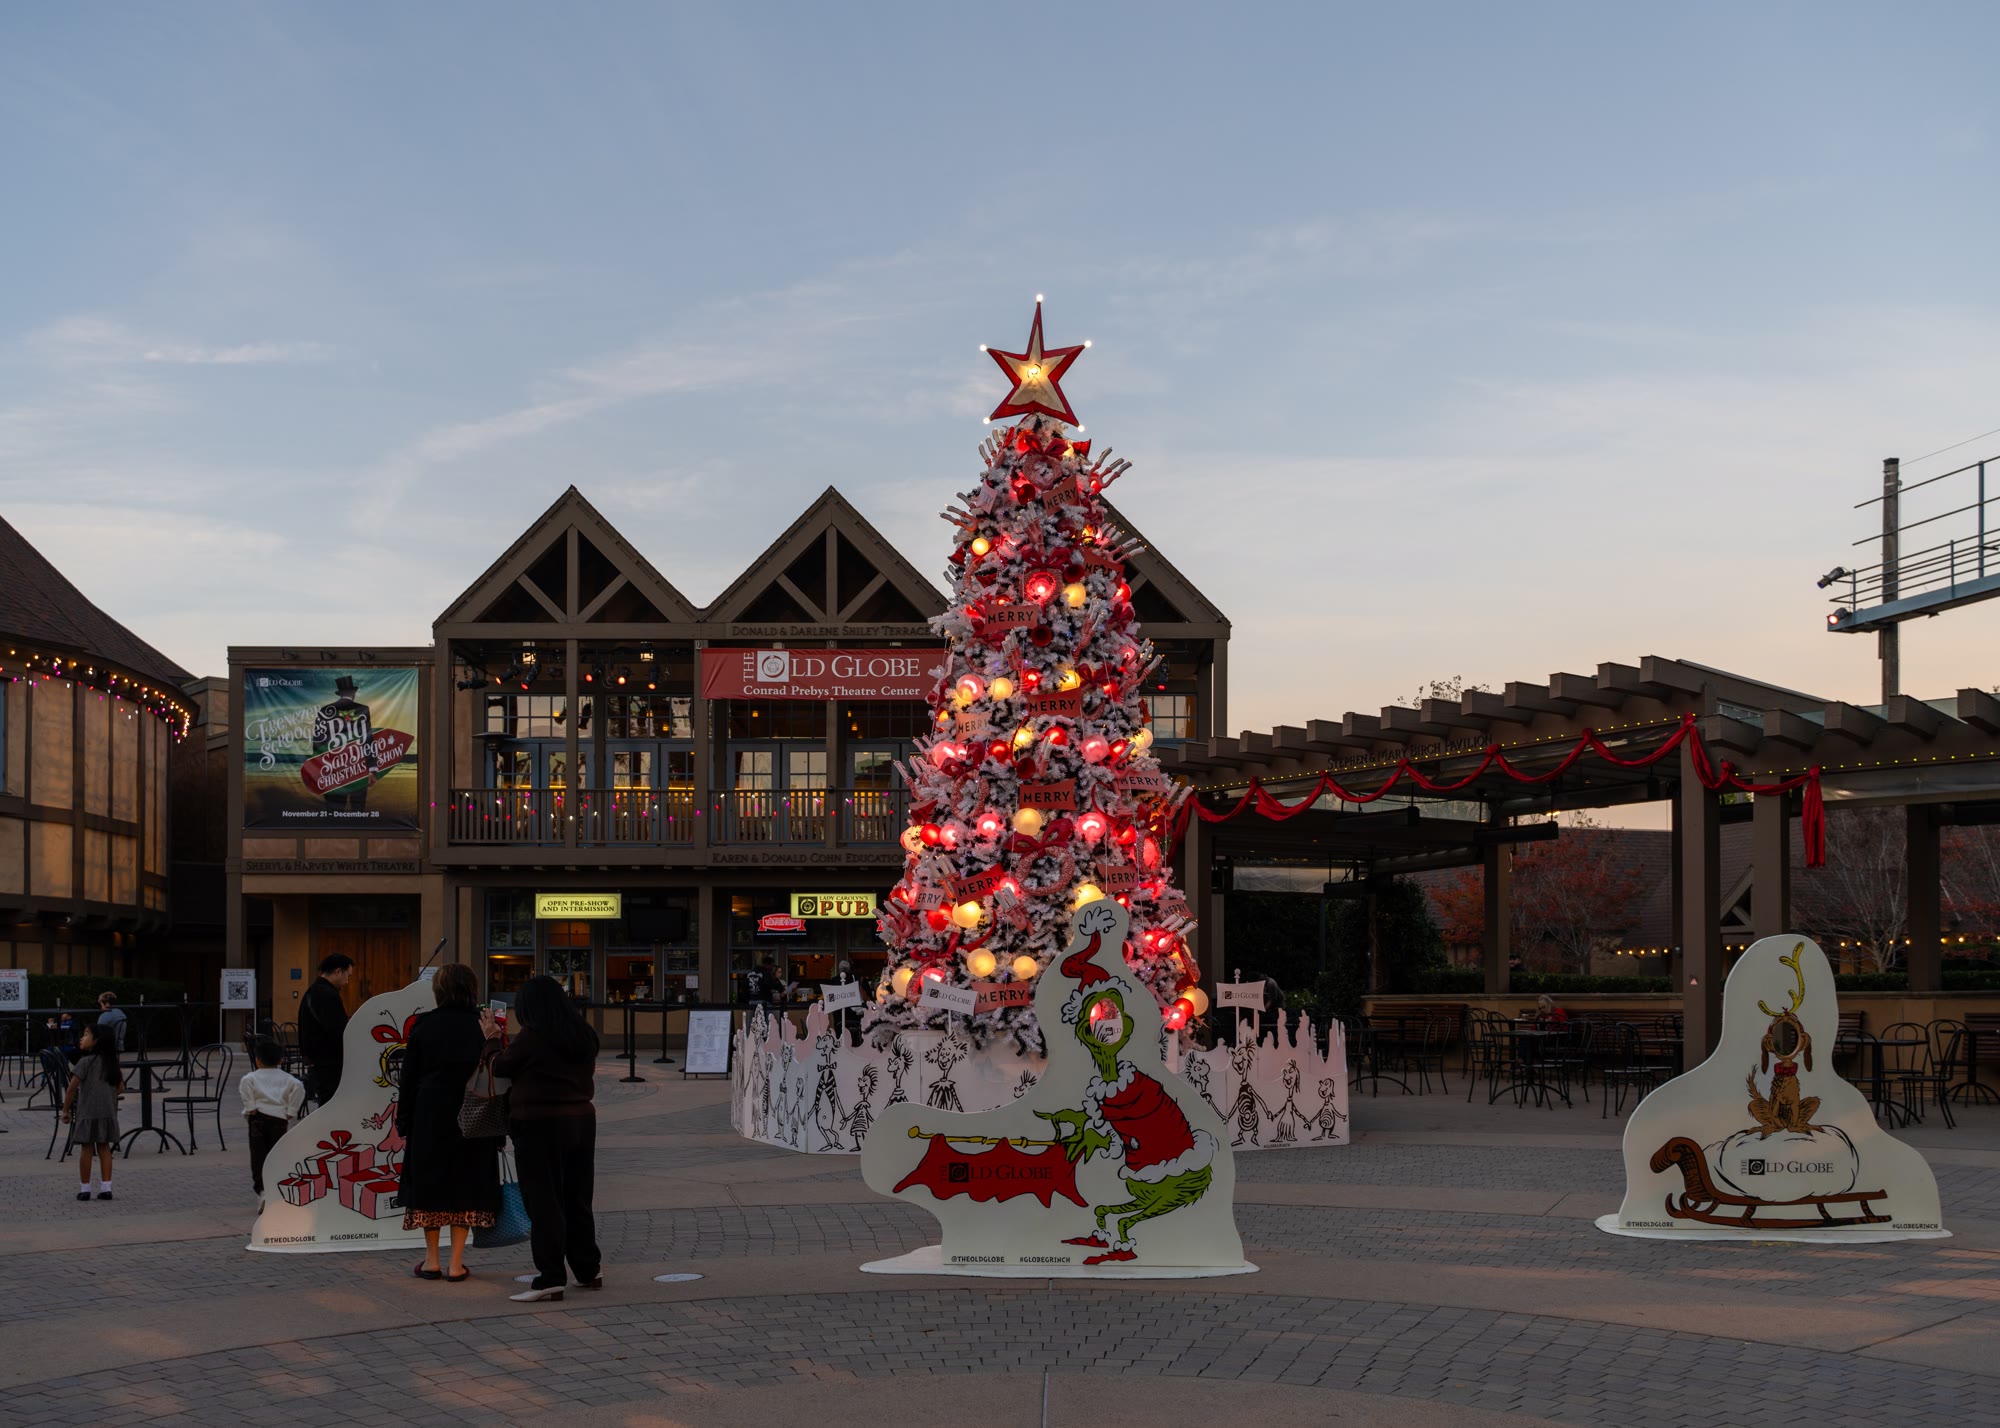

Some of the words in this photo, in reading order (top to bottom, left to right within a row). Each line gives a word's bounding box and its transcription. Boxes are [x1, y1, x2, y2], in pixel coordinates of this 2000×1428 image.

[1047, 487, 1077, 510] MERRY
[988, 611, 1034, 625] MERRY
[732, 626, 778, 636] DONALD
[780, 627, 788, 636] &
[791, 626, 839, 636] DARLENE
[842, 626, 879, 636] SHILEY
[743, 651, 755, 682] THE
[831, 655, 921, 678] GLOBE
[743, 685, 787, 696] Conrad
[791, 685, 829, 699] Prebys
[831, 685, 877, 696] Theatre
[881, 685, 921, 696] Center
[1029, 700, 1076, 712] MERRY
[958, 719, 989, 733] MERRY
[1378, 749, 1407, 761] MARY
[1410, 743, 1441, 757] BIRCH
[1445, 735, 1493, 751] PAVILION
[376, 744, 404, 768] SHOW
[1120, 776, 1158, 788] MERRY
[1023, 791, 1070, 803] MERRY
[712, 853, 749, 863] KAREN
[762, 853, 807, 863] DONALD
[810, 853, 842, 863] COHN
[246, 861, 283, 871] SHERYL
[294, 861, 335, 871] HARVEY
[335, 861, 369, 871] WHITE
[370, 861, 416, 871] THEATRE
[958, 875, 1002, 897] MERRY
[917, 893, 941, 904] ERRY
[819, 900, 869, 916] PUB
[978, 989, 1026, 1004] MERRY
[996, 1164, 1053, 1180] GLOBE
[1740, 1159, 1748, 1176] THE
[1787, 1160, 1834, 1175] GLOBE
[263, 1236, 316, 1244] @THEOLDGLOBE
[330, 1232, 379, 1241] #GLOBEGRINCH
